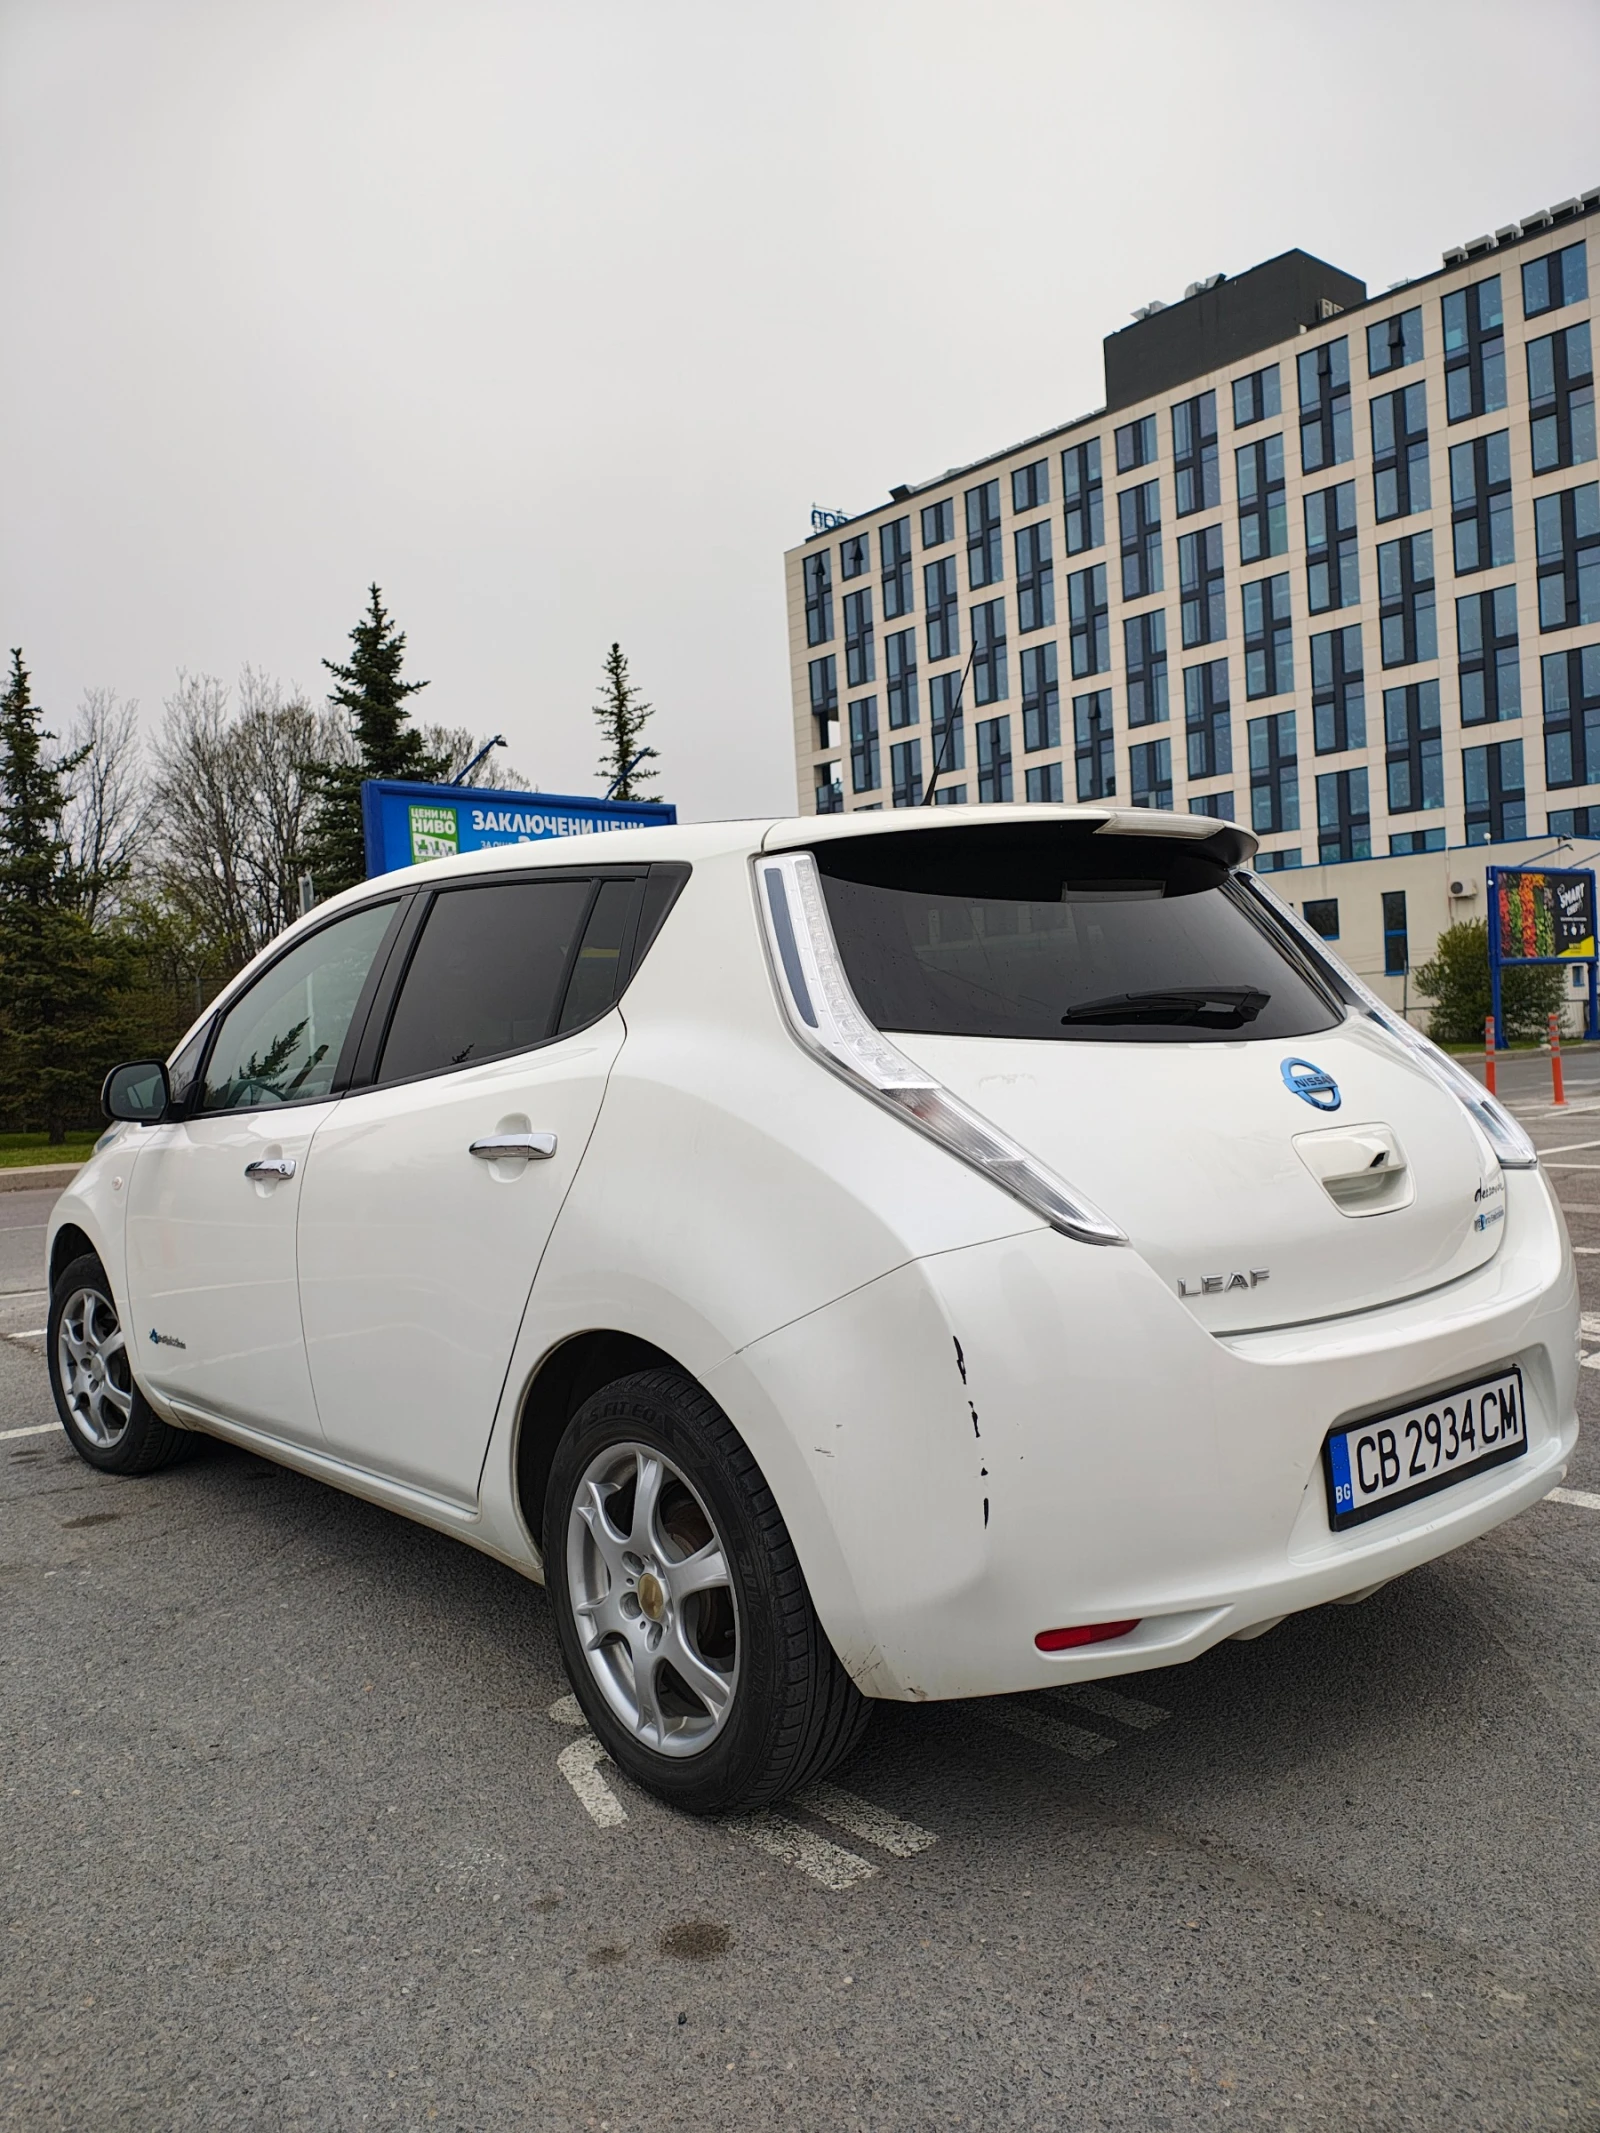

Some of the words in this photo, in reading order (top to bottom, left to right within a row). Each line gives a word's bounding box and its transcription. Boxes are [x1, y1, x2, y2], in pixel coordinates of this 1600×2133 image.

[411, 808, 438, 819] ЦЕНИ
[439, 810, 454, 820] НА
[471, 810, 593, 836] ЗАКЛЮЧЕНИ
[412, 818, 456, 835] НИВО
[1559, 882, 1585, 909] SMART
[1294, 1075, 1333, 1088] NISSAN
[1177, 1267, 1270, 1299] LEAF
[603, 1401, 629, 1418] FIT
[1405, 1398, 1475, 1478] 2934
[1335, 1483, 1351, 1504] BG
